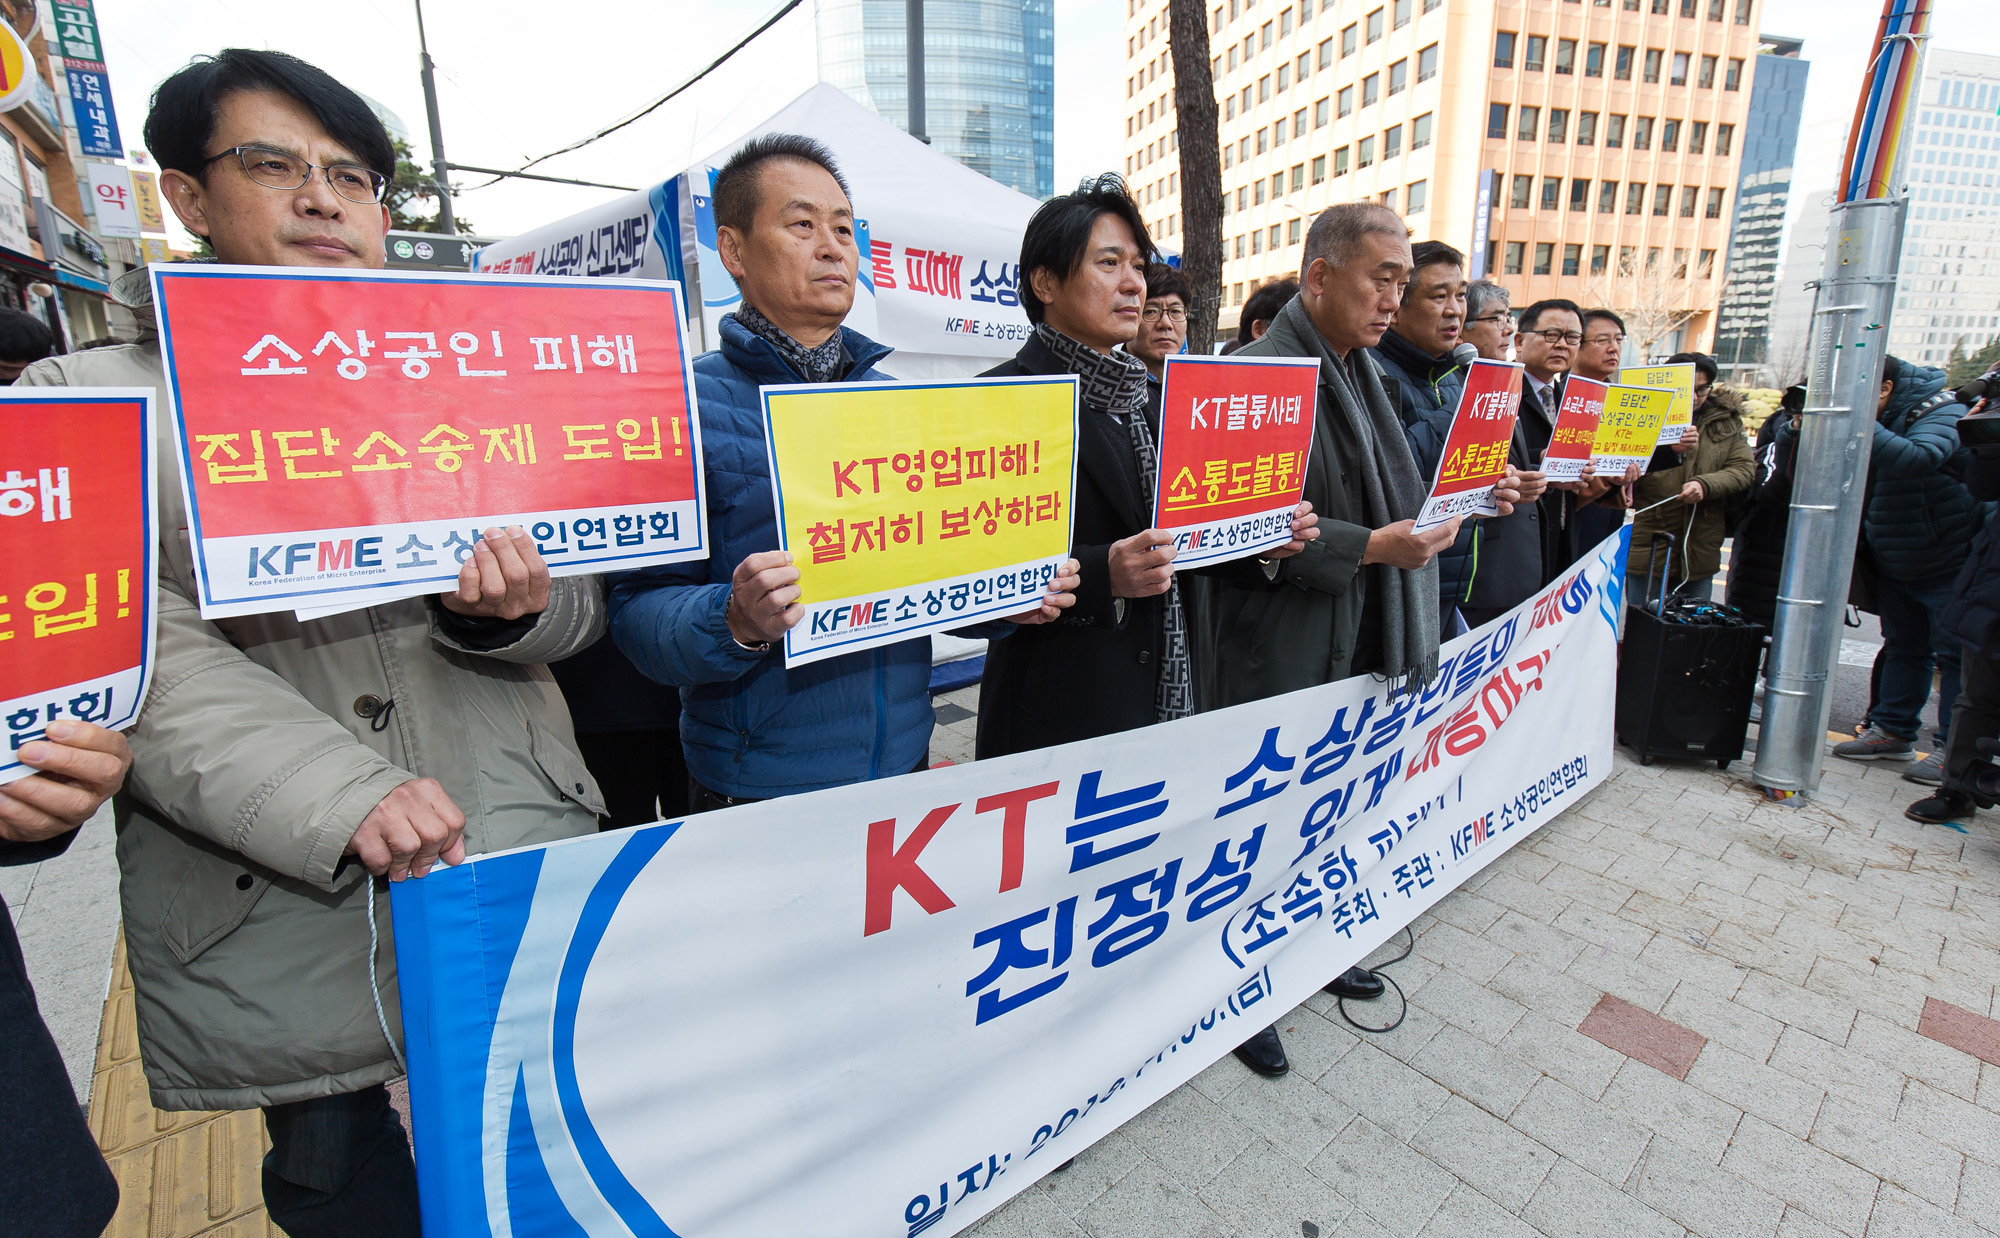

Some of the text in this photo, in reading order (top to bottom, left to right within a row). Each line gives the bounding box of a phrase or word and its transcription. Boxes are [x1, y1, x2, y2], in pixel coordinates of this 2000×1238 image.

[57, 6, 98, 61] 고시텔
[82, 73, 111, 142] 연세내과
[97, 184, 128, 211] 약
[586, 213, 649, 277] 신고센터
[905, 246, 964, 300] 피해
[945, 317, 980, 334] KFME
[240, 329, 638, 381] 소상공인 피해
[1647, 371, 1673, 385] 답답한
[1190, 394, 1302, 431] KT불통사태
[1563, 396, 1585, 414] 요금은
[1620, 393, 1650, 409] 답답한
[1673, 386, 1688, 399] 정!
[1554, 427, 1576, 444] 보상은
[1614, 428, 1633, 440] KT는
[1637, 412, 1661, 429] 심정!
[194, 416, 683, 485] 집단소송제 도입!
[832, 439, 1041, 498] KT영업피해!
[1167, 450, 1304, 503] 소통도불통!
[0, 466, 72, 523] 해
[248, 511, 680, 579] KFME 소상인연합회
[806, 490, 1062, 565] 철저히 보상하라
[249, 579, 272, 587] Korea
[274, 575, 316, 584] Federation
[327, 571, 348, 579] Micro
[350, 567, 387, 577] Enterprise
[811, 562, 1058, 635] KFME 소상공인연합회
[0, 568, 130, 642] 입!
[863, 769, 1170, 938] KT는
[1214, 612, 1522, 820] 소상공인들의
[965, 822, 1268, 1027] 진정성
[1404, 642, 1560, 784] 대응하
[1332, 887, 1380, 940] 주최
[1392, 852, 1435, 899] 주관
[1450, 810, 1496, 861] KFME
[1500, 754, 1588, 832] 소상공인연합회
